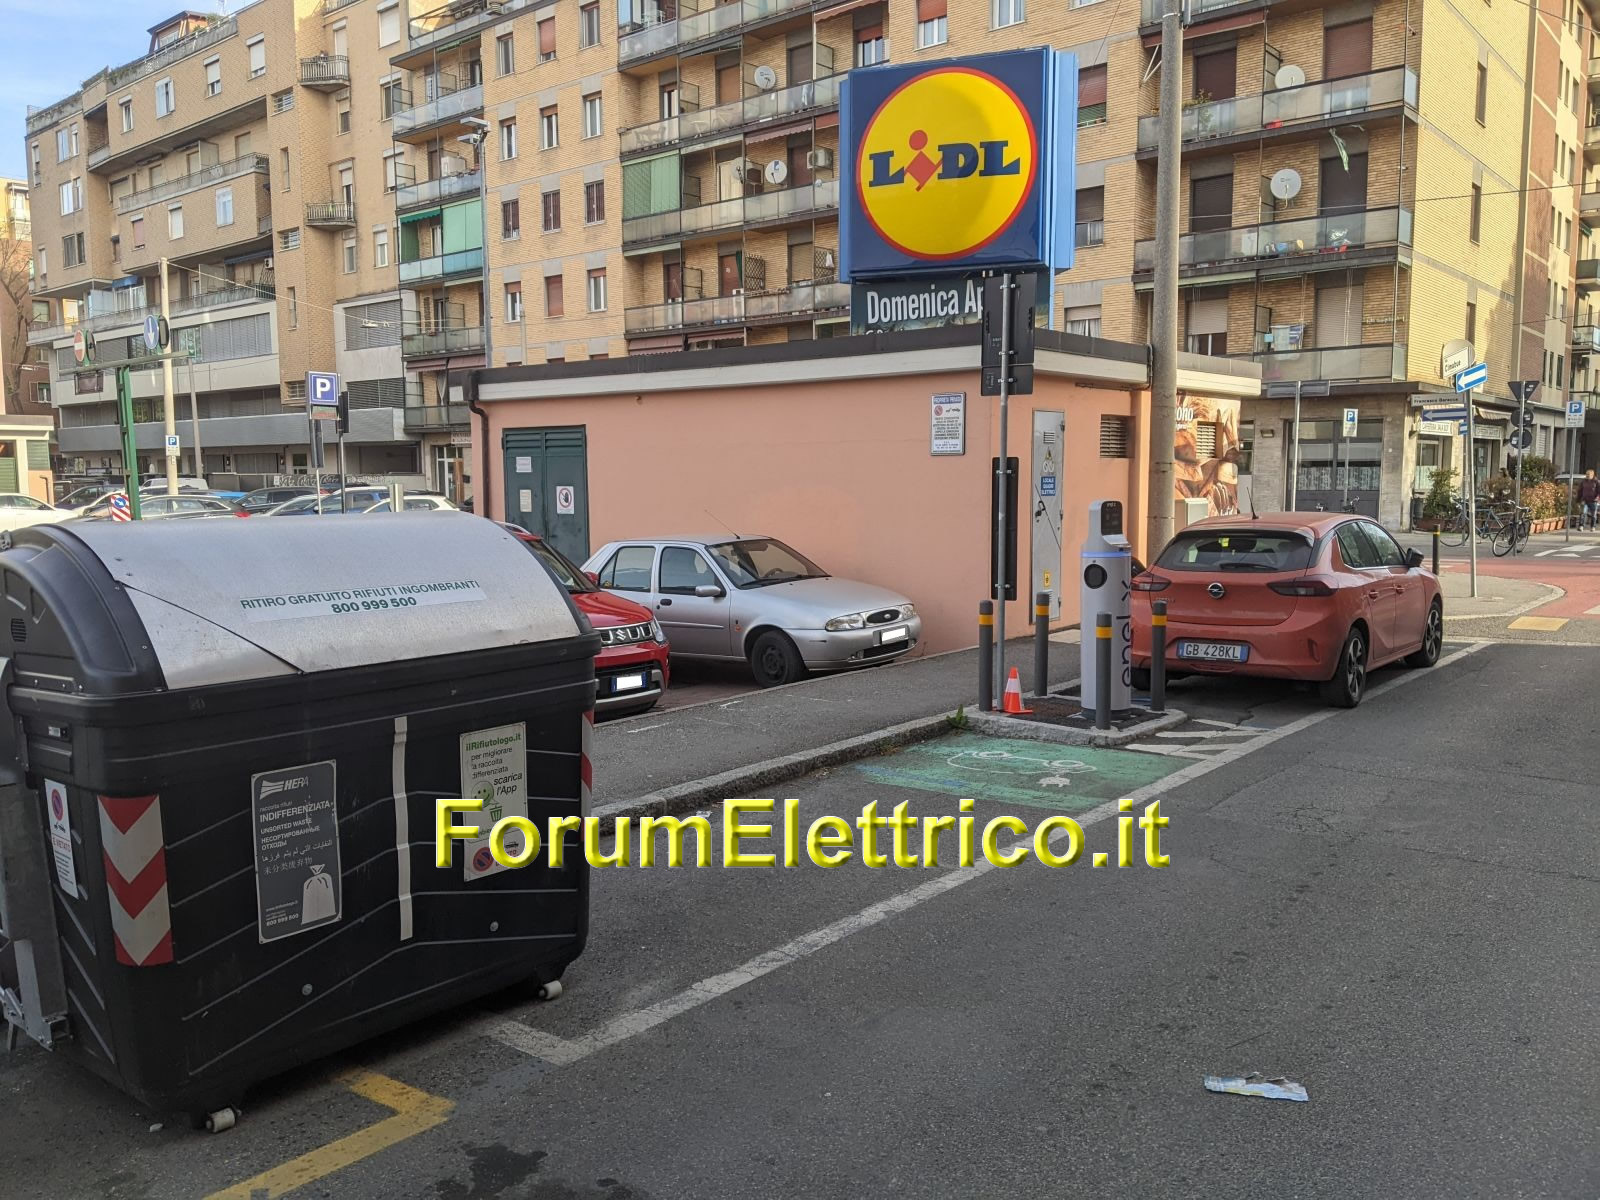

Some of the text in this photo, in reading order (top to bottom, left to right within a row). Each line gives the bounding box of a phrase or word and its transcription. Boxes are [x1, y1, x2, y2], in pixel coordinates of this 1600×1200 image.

[866, 284, 959, 324] Domenica
[316, 378, 331, 399] P
[1571, 403, 1580, 413] P
[1347, 411, 1354, 421] P
[169, 437, 176, 445] P
[240, 580, 481, 610] RITIRO GRATUITO RIFIUTI INGOMBRANTI
[331, 596, 418, 614] 800 999 500
[1185, 643, 1239, 659] GB 428KL
[465, 733, 522, 752] ilRifiutologo.it
[471, 747, 513, 761] per migliorare
[478, 758, 503, 768] raccolta
[472, 765, 509, 779] differenziata
[493, 772, 523, 786] scarica
[284, 776, 309, 791] HERA
[496, 784, 518, 796] l'App
[260, 800, 331, 823] INDIFFERENZIATA
[260, 817, 313, 835] UNSORTED WASTE
[261, 824, 321, 844] НЕСОРТИРОВАННЫЕ
[261, 840, 288, 851] ОТХОДЫ
